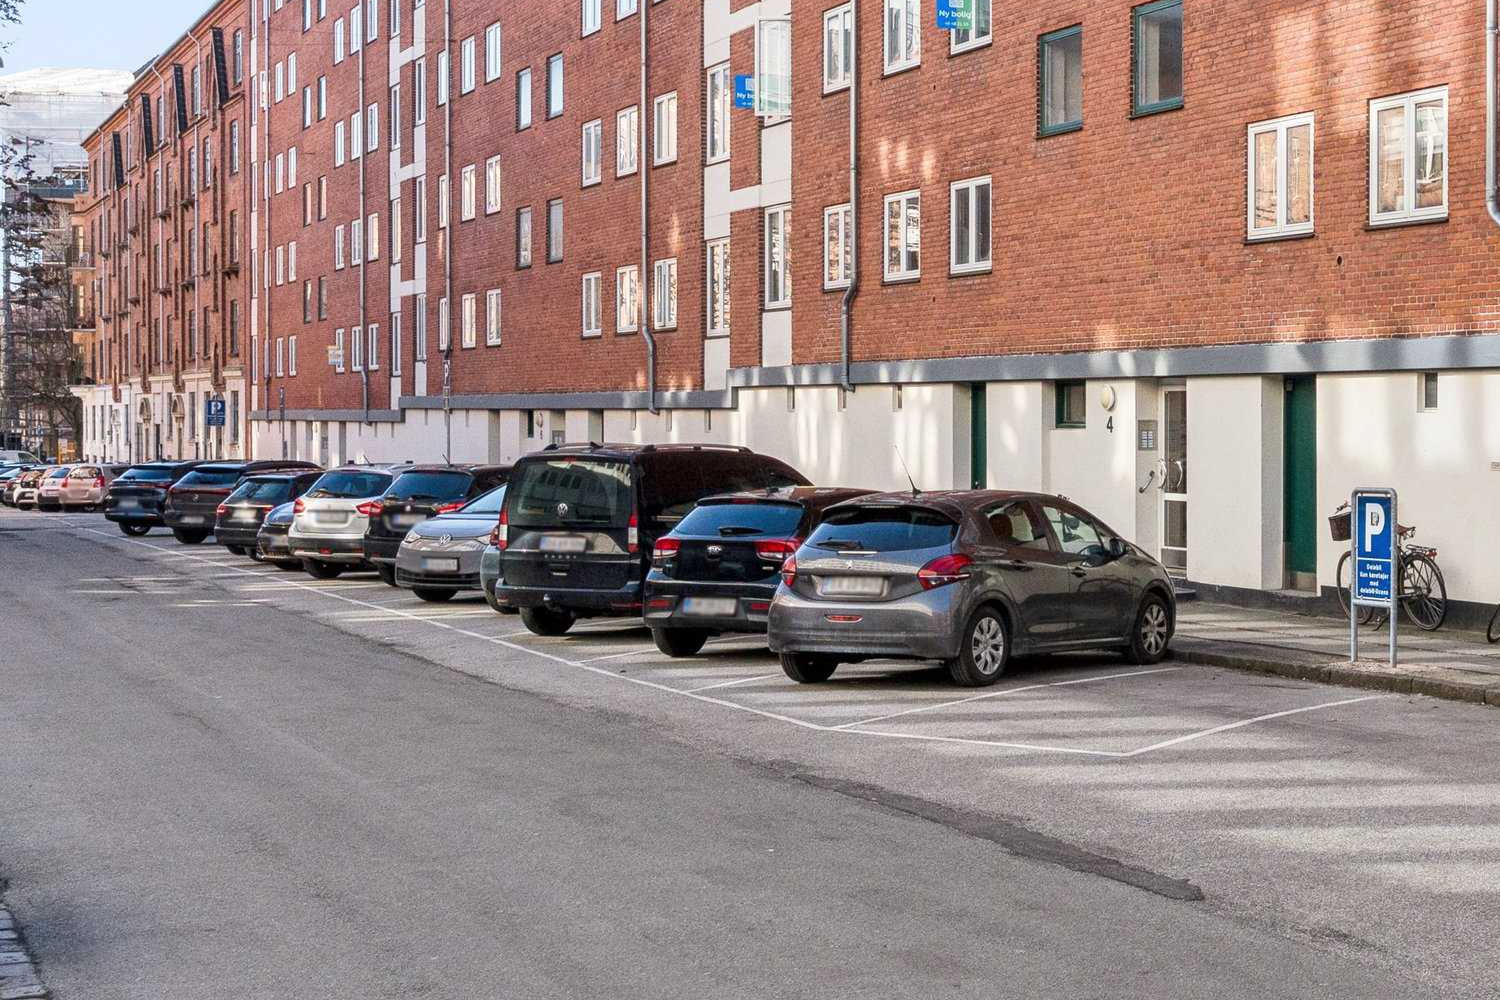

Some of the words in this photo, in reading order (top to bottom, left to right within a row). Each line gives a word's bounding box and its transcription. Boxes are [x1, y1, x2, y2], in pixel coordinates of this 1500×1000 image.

[939, 10, 950, 18] Ny
[951, 10, 973, 19] bolig
[211, 401, 221, 414] P
[1106, 416, 1114, 433] 4
[1365, 503, 1385, 552] P
